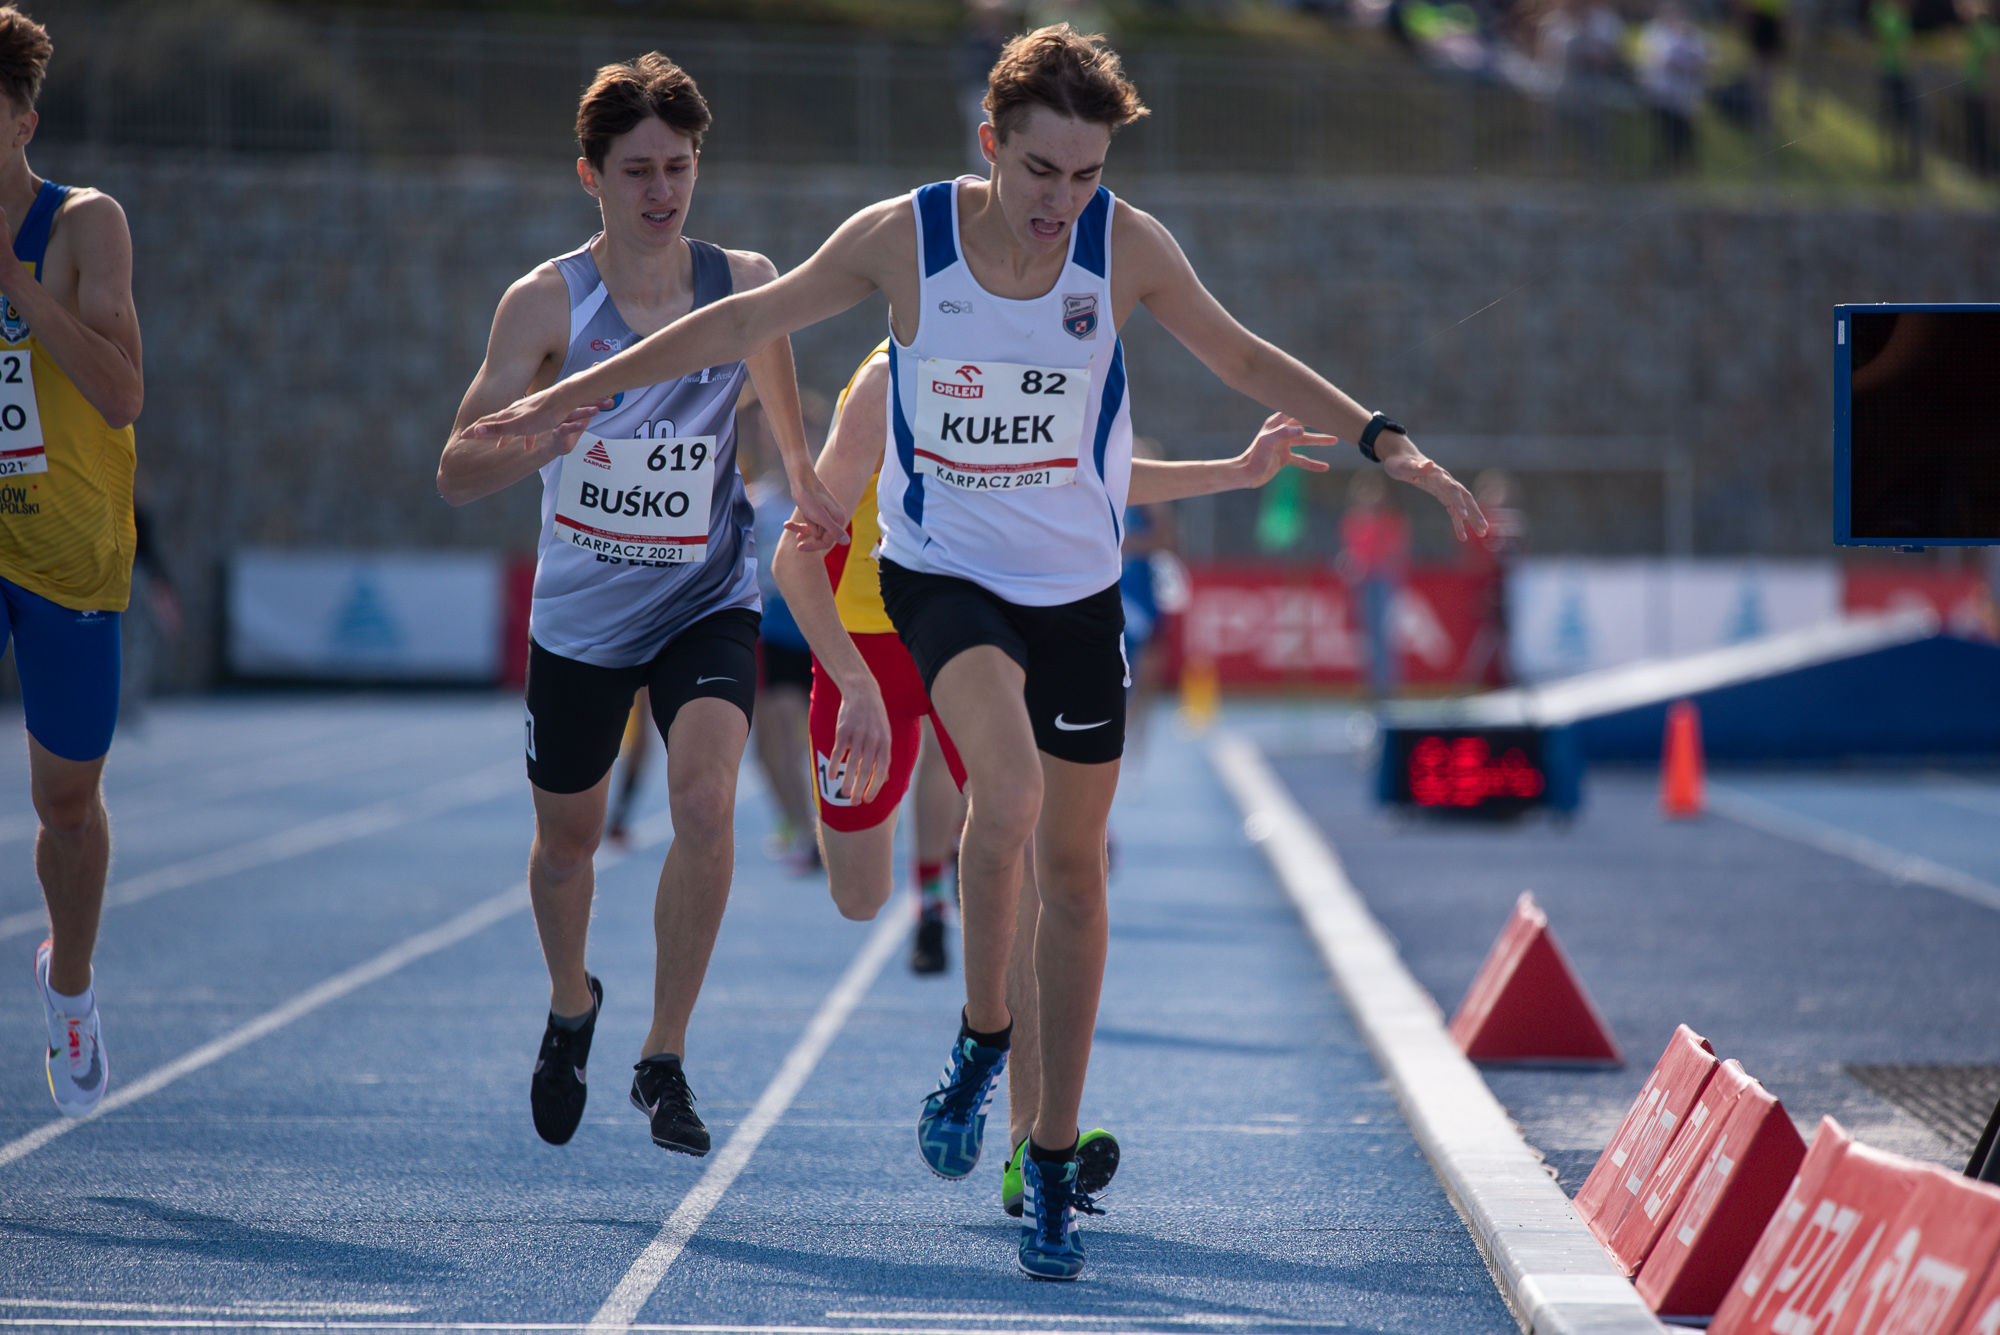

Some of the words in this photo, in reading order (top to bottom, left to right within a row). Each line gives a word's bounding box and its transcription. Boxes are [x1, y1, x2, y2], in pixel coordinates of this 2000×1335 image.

[0, 356, 23, 384] 2
[1021, 370, 1067, 395] 82
[934, 383, 981, 397] ORLEN
[0, 404, 27, 431] O
[940, 412, 1056, 445] KUŁEK
[583, 457, 613, 471] KARPACZ
[647, 442, 708, 472] 619
[936, 466, 1012, 489] KARPACZ
[1015, 471, 1051, 487] 2021
[0, 483, 27, 503] ÓW
[579, 480, 690, 518] BUŚKO
[572, 532, 645, 558] KARPACZ
[648, 547, 684, 560] 2021
